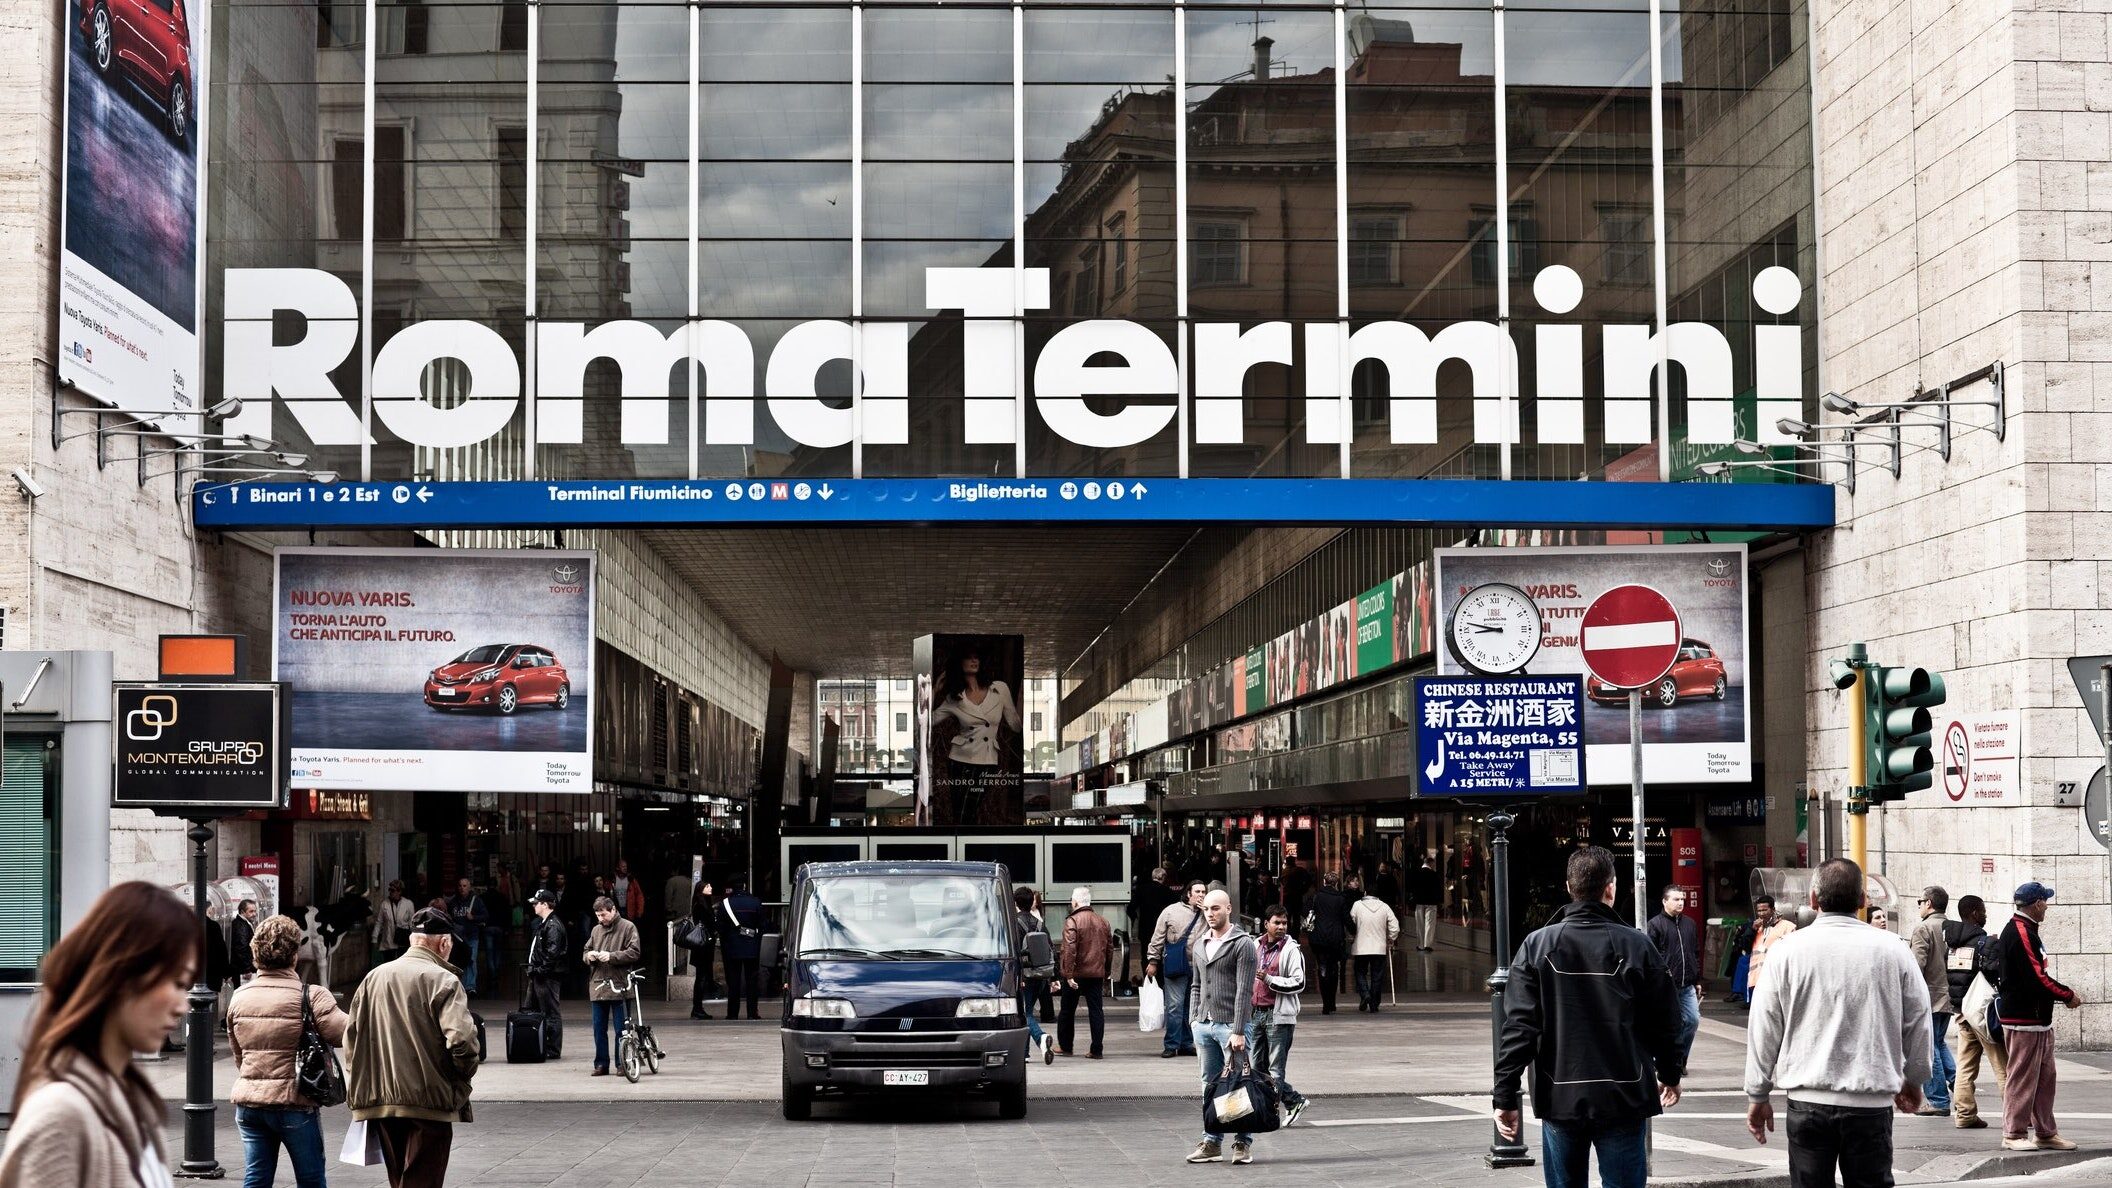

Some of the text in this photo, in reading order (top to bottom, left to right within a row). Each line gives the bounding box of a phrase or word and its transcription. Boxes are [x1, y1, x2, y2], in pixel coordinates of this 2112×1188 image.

[250, 488, 380, 502] Binari 1 e 2 Est
[548, 485, 713, 500] Terminal Fiumicino
[950, 484, 1047, 501] Biglietteria
[1703, 580, 1737, 588] TOYOTA
[549, 586, 584, 594] TOYOTA
[1525, 584, 1582, 599] YARIS.
[290, 591, 415, 607] NUOVA YARIS.
[291, 614, 387, 627] TORNA L'AUTO
[290, 628, 456, 642] CHE ANTICIPA IL FUTURO.
[1424, 682, 1575, 696] CHINESE RESTAURANT
[1424, 698, 1576, 728] 新金洲酒家
[1974, 720, 2008, 733] Vietato fumare
[1444, 731, 1578, 747] Via Magenta, 55
[1974, 738, 2005, 749] nella stazione
[299, 755, 321, 764] Toyota
[1449, 751, 1525, 759] Tel. 06.49.14.71
[547, 762, 567, 770] Today
[1459, 762, 1515, 770] Take Away
[1974, 772, 2001, 782] Don't smoke
[1450, 779, 1458, 787] A
[1460, 778, 1473, 788] 15
[2059, 783, 2076, 794] 27
[1974, 789, 2003, 798] in the station
[1680, 847, 1696, 856] SOS
